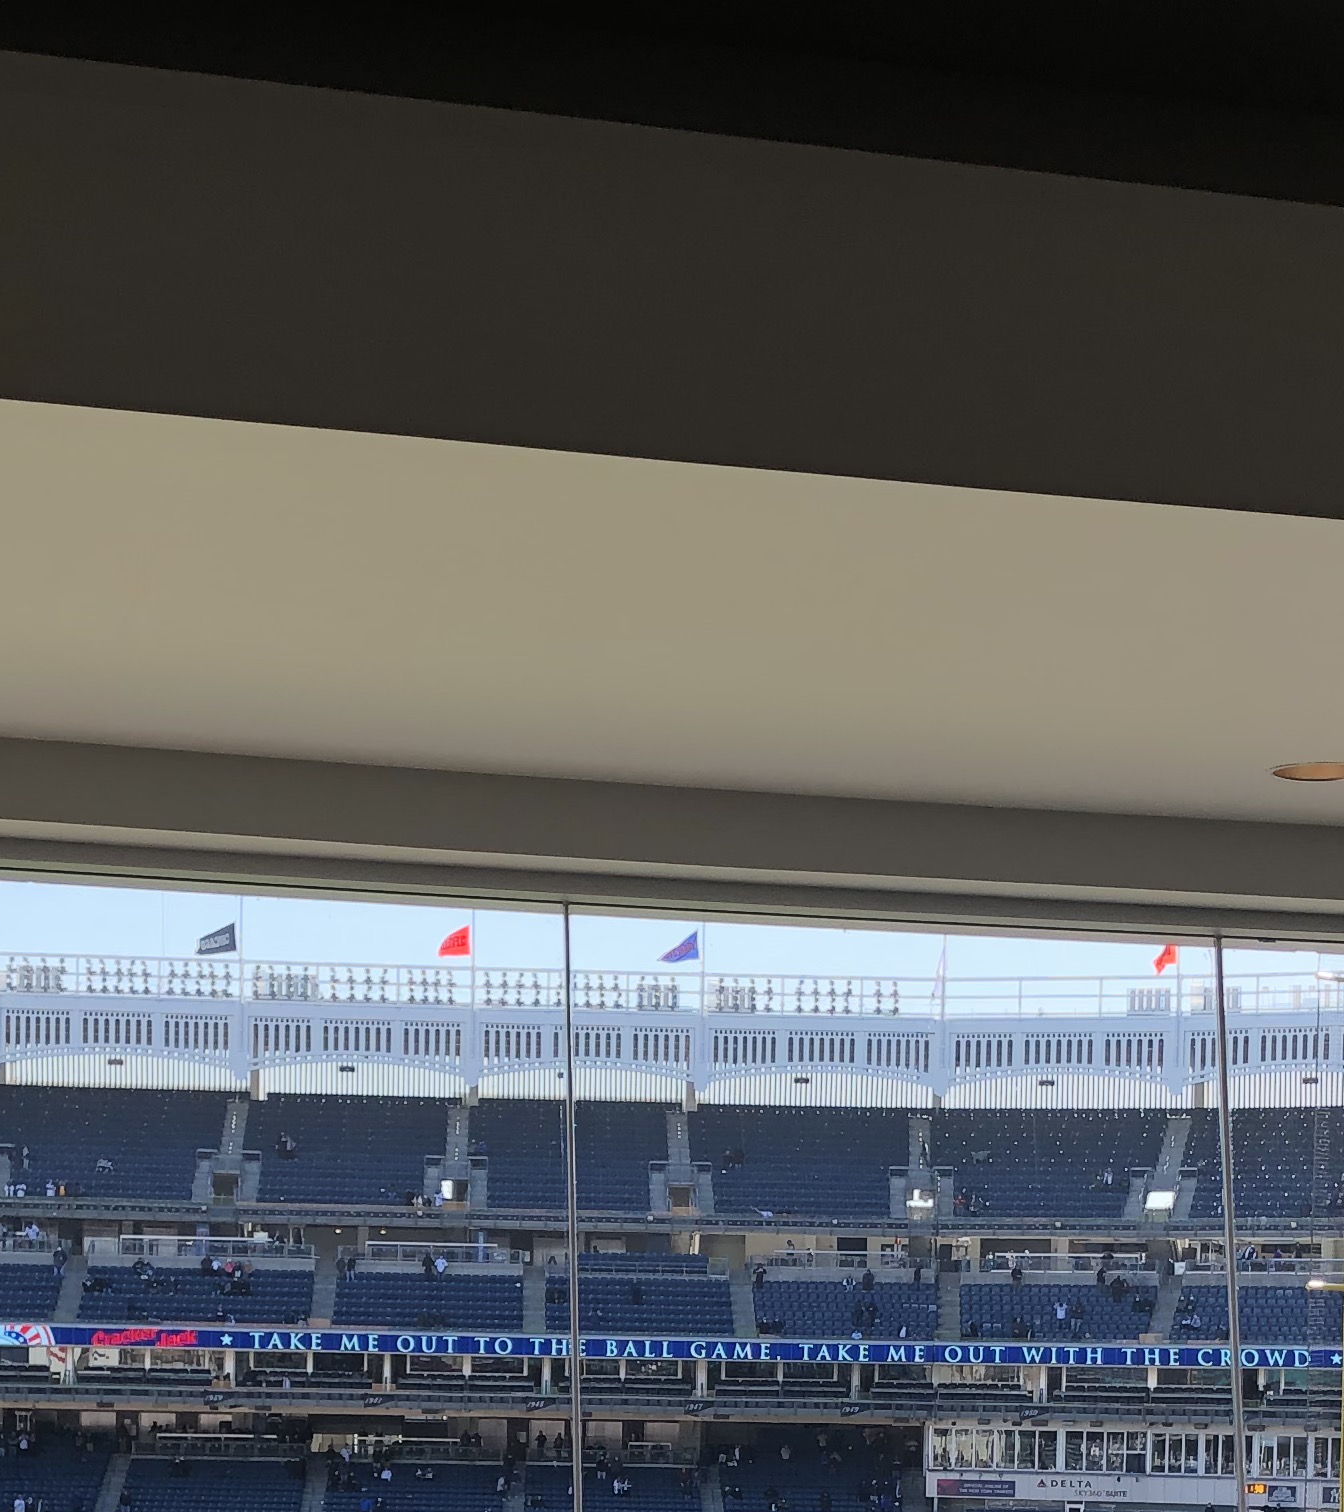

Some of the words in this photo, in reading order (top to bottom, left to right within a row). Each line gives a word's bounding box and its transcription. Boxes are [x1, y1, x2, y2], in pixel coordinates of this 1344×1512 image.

[250, 1332, 322, 1350] TAKE
[340, 1334, 380, 1352] ME
[396, 1335, 458, 1353] OUT
[474, 1337, 514, 1355] TO
[530, 1338, 586, 1356] THE
[606, 1340, 674, 1358] BALL
[690, 1341, 781, 1362] GAME,
[799, 1343, 870, 1362] TAKE
[888, 1345, 926, 1363] ME
[945, 1346, 1006, 1365] OUT
[1022, 1347, 1105, 1365] WITH
[1121, 1348, 1179, 1367] THE
[1197, 1348, 1311, 1368] CROWD
[1051, 1479, 1092, 1488] DELTA
